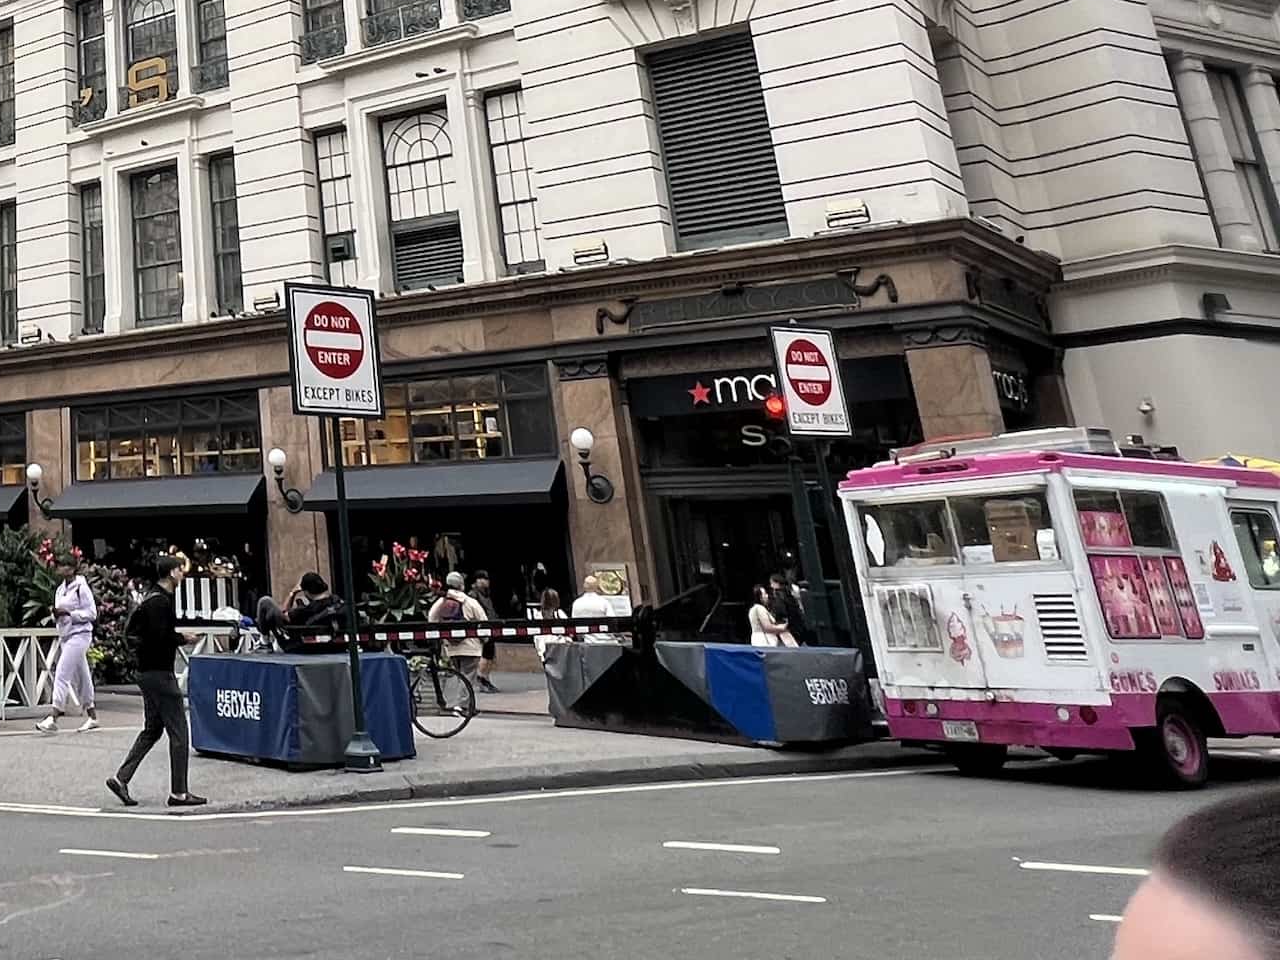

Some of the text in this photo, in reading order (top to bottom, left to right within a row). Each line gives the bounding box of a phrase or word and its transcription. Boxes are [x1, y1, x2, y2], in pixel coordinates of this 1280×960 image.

[313, 314, 351, 329] DO NOT
[317, 351, 351, 366] ENTER
[791, 351, 820, 362] DO NOT
[304, 386, 374, 403] EXCEPT BIKES
[798, 382, 824, 394] ENTER
[793, 412, 846, 425] EXCEPT BIKES
[217, 703, 261, 720] SQUARE
